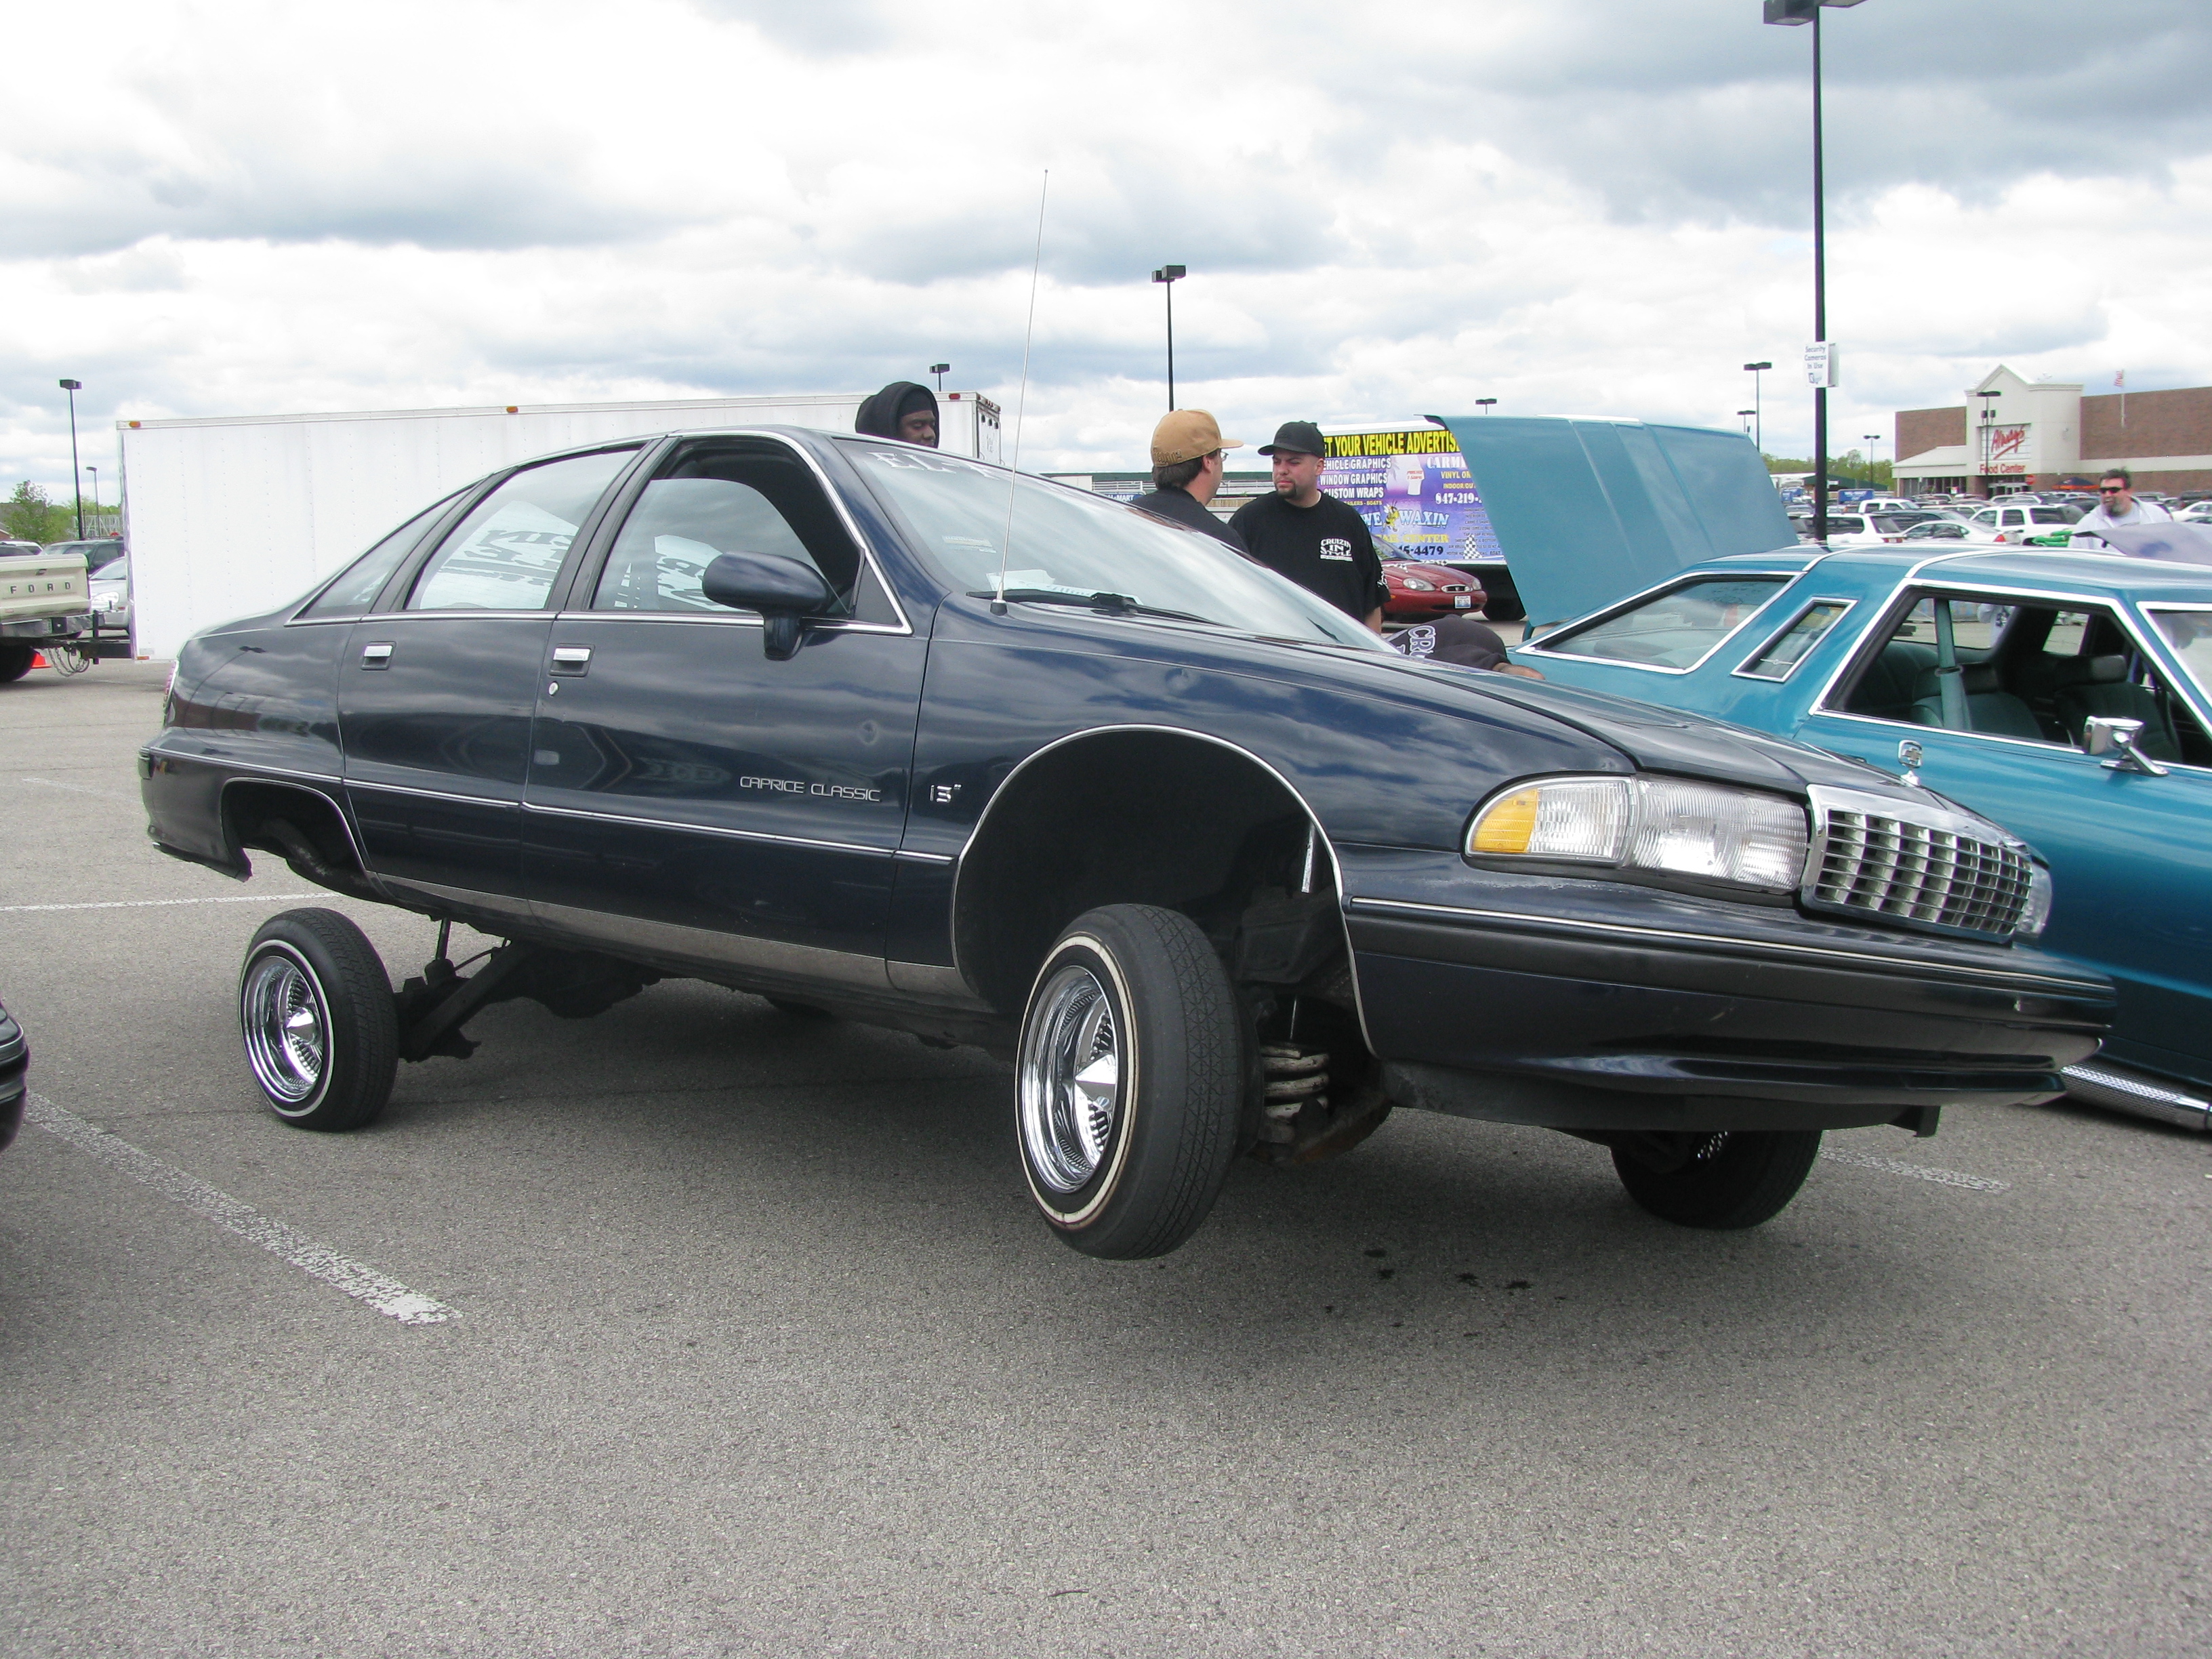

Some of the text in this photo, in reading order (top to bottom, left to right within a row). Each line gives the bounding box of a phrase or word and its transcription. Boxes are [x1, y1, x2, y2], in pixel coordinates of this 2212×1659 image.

[1324, 436, 1332, 457] ET
[1335, 434, 1361, 457] YOUR
[1363, 432, 1404, 455] VEHICLE
[1324, 457, 1391, 471] EHICLE GRAPHICS
[2001, 464, 2026, 474] Center
[1320, 472, 1388, 485] WINDOW GRAPHICS
[1356, 486, 1384, 498] WRAPS
[1399, 510, 1449, 527] WAXIN
[1403, 533, 1449, 543] CENTER
[1320, 546, 1352, 556] STYLE
[10, 582, 71, 594] FORD
[739, 776, 882, 802] CAPRICE CLASSIC
